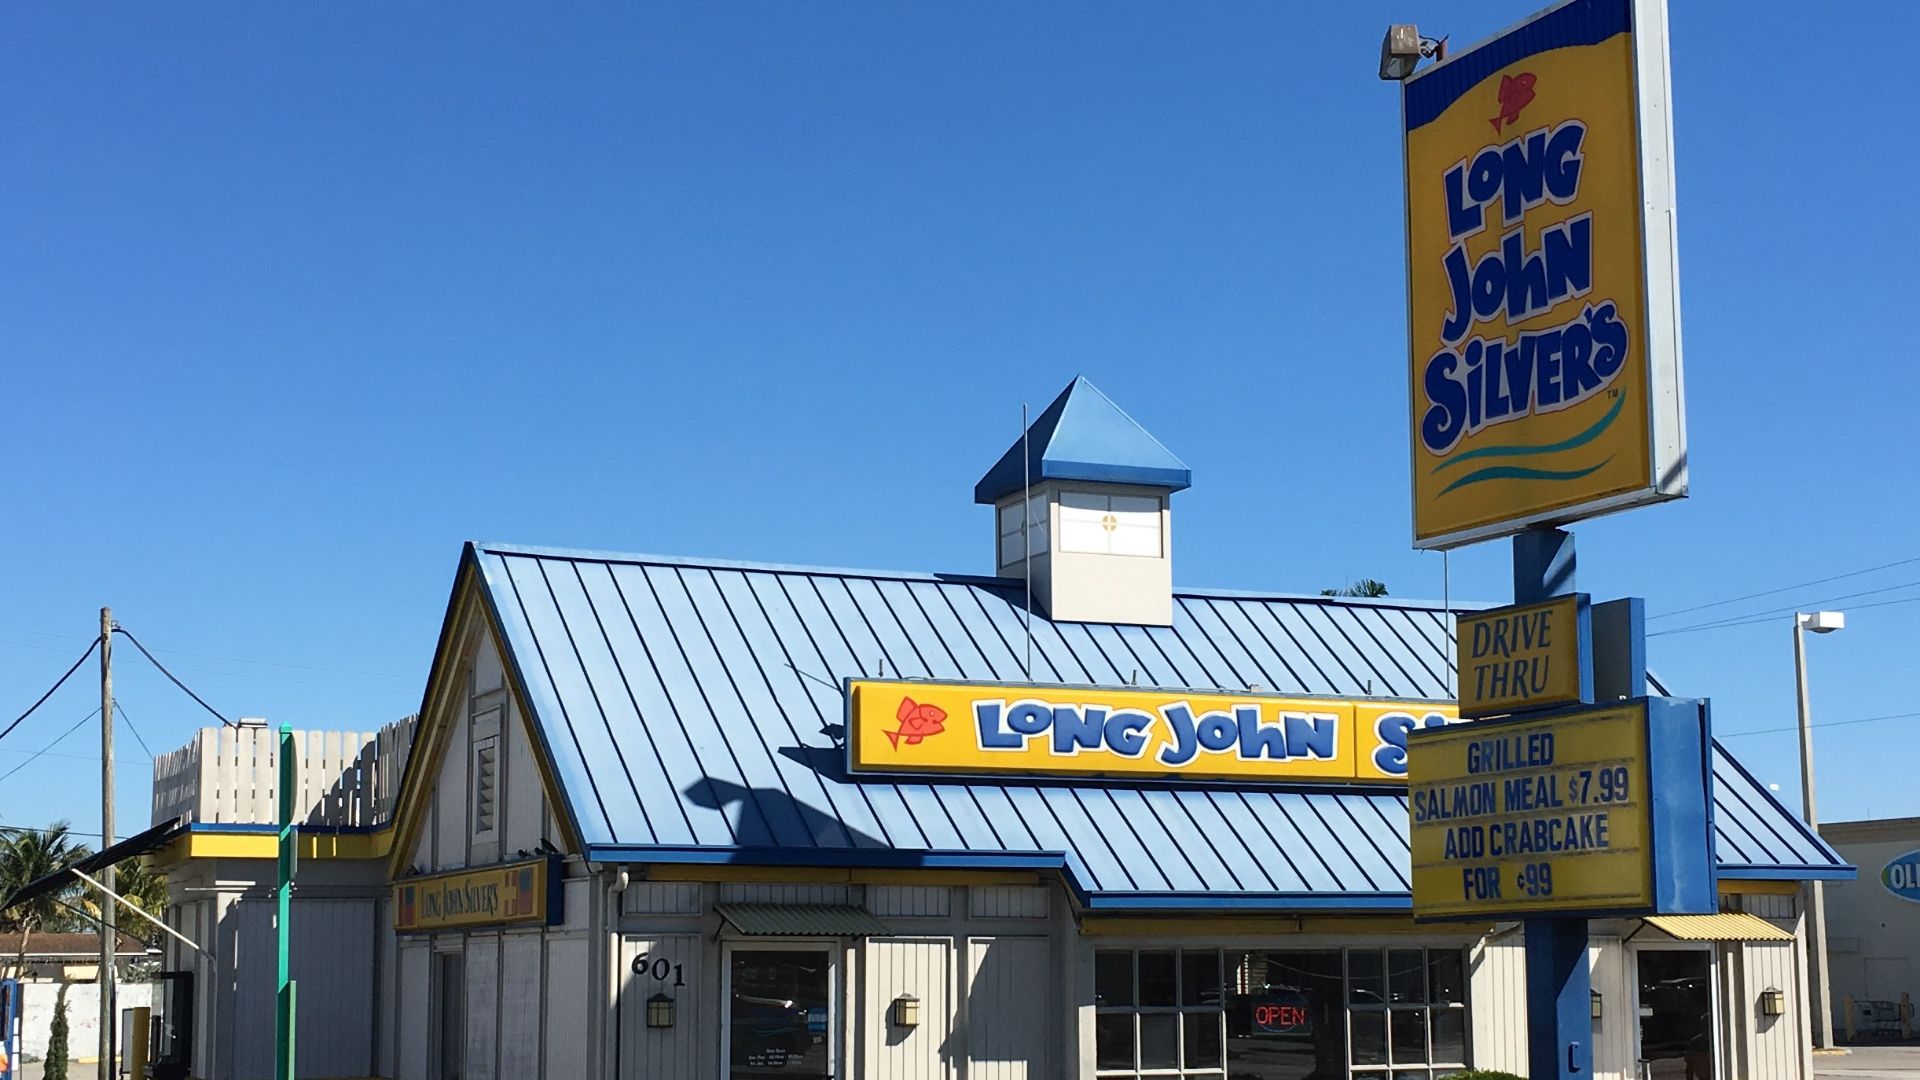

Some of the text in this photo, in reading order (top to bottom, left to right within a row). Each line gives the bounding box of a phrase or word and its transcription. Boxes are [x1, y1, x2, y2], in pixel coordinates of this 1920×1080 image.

[1472, 610, 1552, 659] DRIVE
[1474, 656, 1549, 699] THRU
[1467, 732, 1554, 774] GRILLED
[1414, 767, 1629, 822] SALMON MEAL $7.99
[1444, 814, 1609, 860] ADD CRABCAKE
[1463, 867, 1500, 900] FOR
[631, 952, 685, 987] 601
[1256, 1007, 1305, 1025] OPEN
